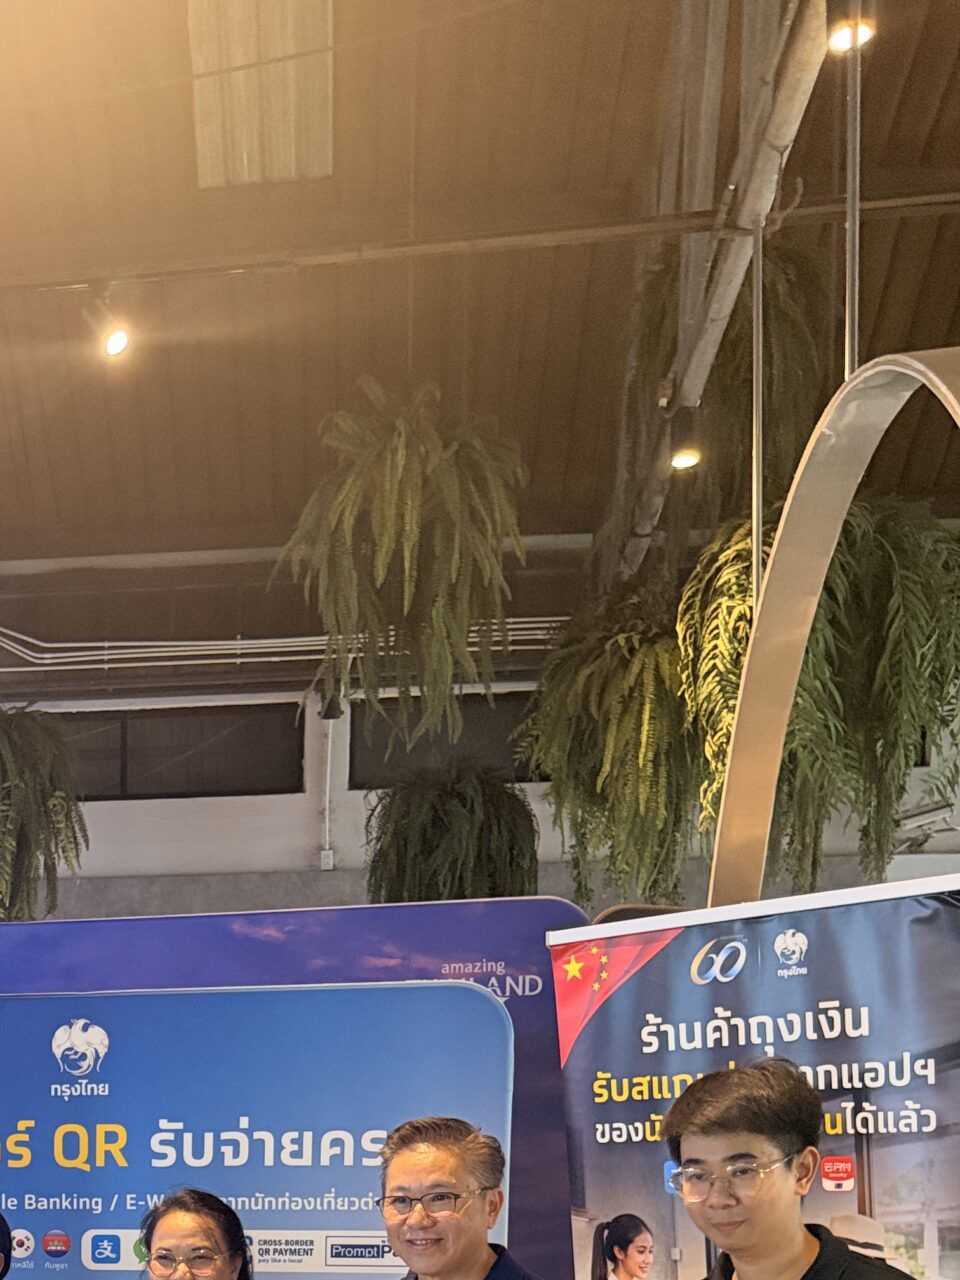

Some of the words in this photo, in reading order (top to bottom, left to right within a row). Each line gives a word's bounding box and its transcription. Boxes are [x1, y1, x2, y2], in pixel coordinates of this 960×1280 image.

[441, 959, 506, 975] amazing
[641, 1001, 870, 1056] ร้านค้าถุงเงิน
[50, 1079, 109, 1101] กรุงไทย
[53, 1123, 129, 1172] QR
[24, 1194, 102, 1213] Banking
[258, 1248, 270, 1257] QR
[272, 1247, 314, 1257] PAYMENT
